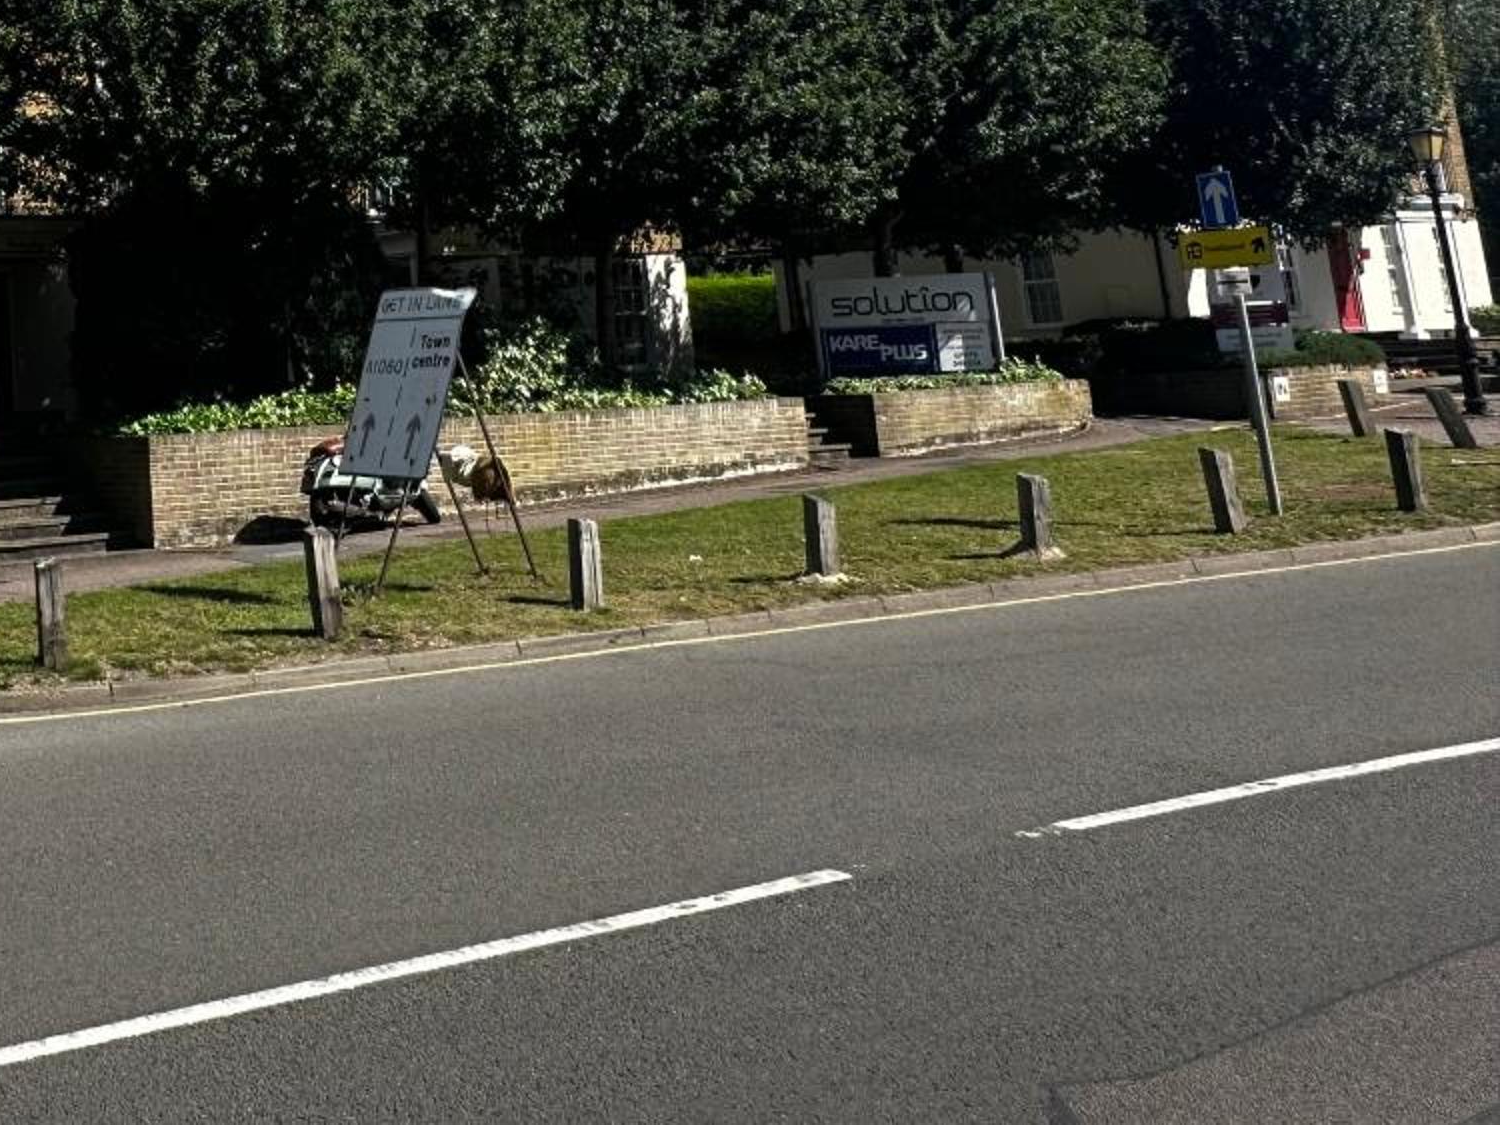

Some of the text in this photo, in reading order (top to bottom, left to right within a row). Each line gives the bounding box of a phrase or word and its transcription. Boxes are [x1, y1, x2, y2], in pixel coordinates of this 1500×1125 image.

[381, 296, 406, 315] GET
[408, 295, 423, 312] IN
[831, 286, 974, 317] solution
[421, 334, 451, 350] Town
[829, 333, 880, 354] KARE
[411, 353, 452, 369] centre
[880, 344, 929, 362] PLUS
